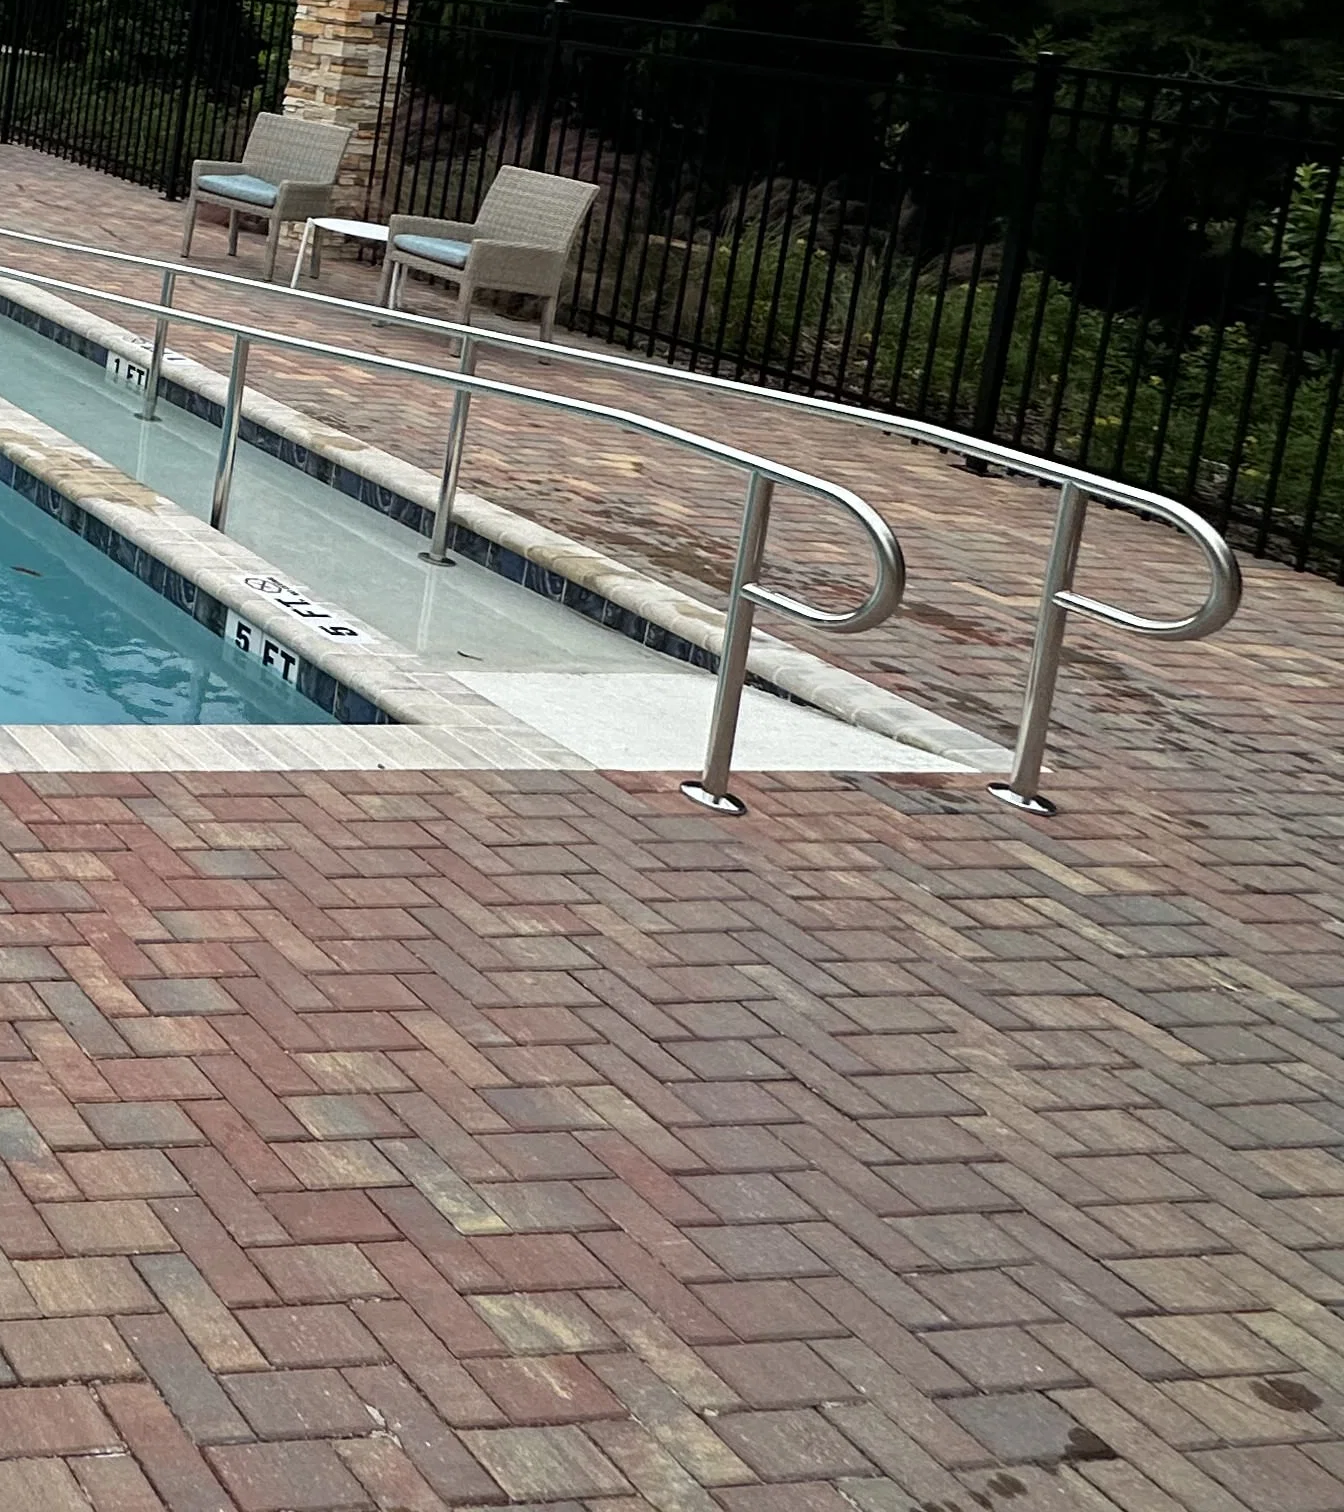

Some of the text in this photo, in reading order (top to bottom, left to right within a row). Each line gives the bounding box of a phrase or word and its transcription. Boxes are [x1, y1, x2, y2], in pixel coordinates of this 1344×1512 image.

[115, 358, 120, 374] 1
[235, 621, 252, 653] 5
[318, 625, 358, 637] 5
